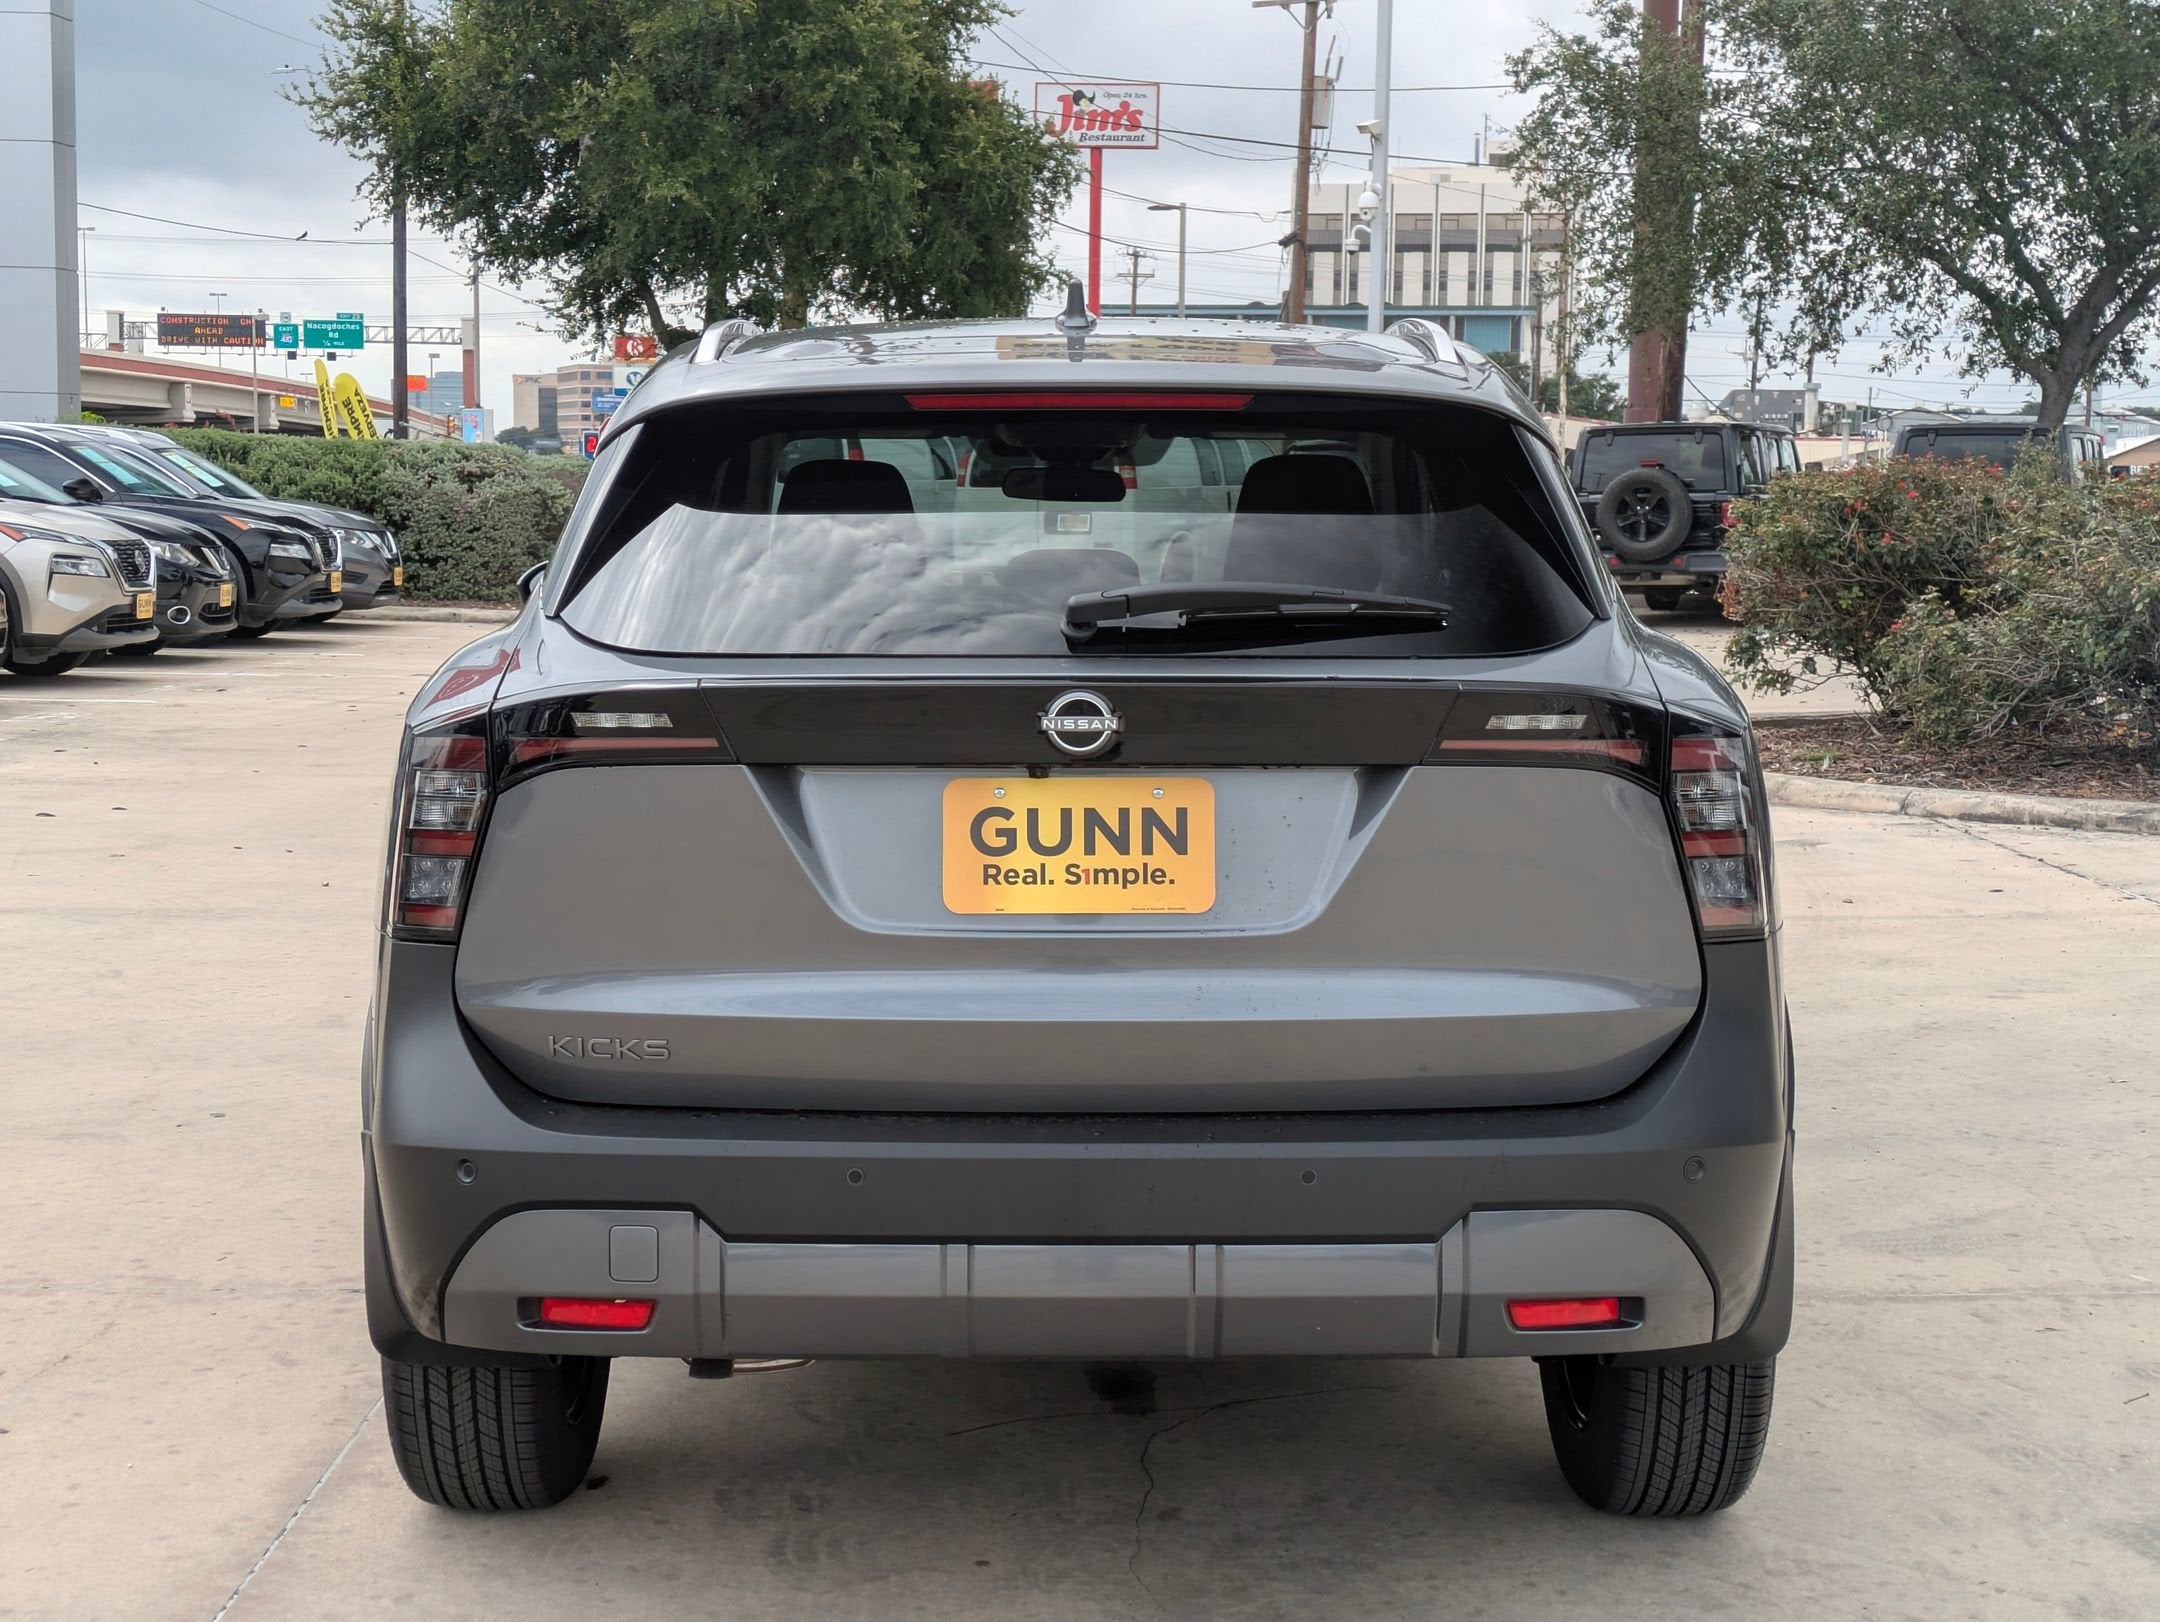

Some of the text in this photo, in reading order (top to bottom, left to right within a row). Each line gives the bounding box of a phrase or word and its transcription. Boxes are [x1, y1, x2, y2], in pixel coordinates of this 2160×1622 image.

[1103, 91, 1121, 99] Open
[1045, 94, 1144, 138] Jim's
[1079, 132, 1146, 142] Restaurant
[160, 316, 229, 325] CONSTRUCTION
[194, 326, 223, 334] AHEAD
[306, 322, 360, 331] Nacogdoches
[161, 335, 264, 345] DRIVE WITH CAUTIN
[1043, 719, 1117, 729] NISSAN
[969, 806, 1188, 857] GUNN
[982, 862, 1055, 886] Real.
[547, 1035, 671, 1061] KICKS
